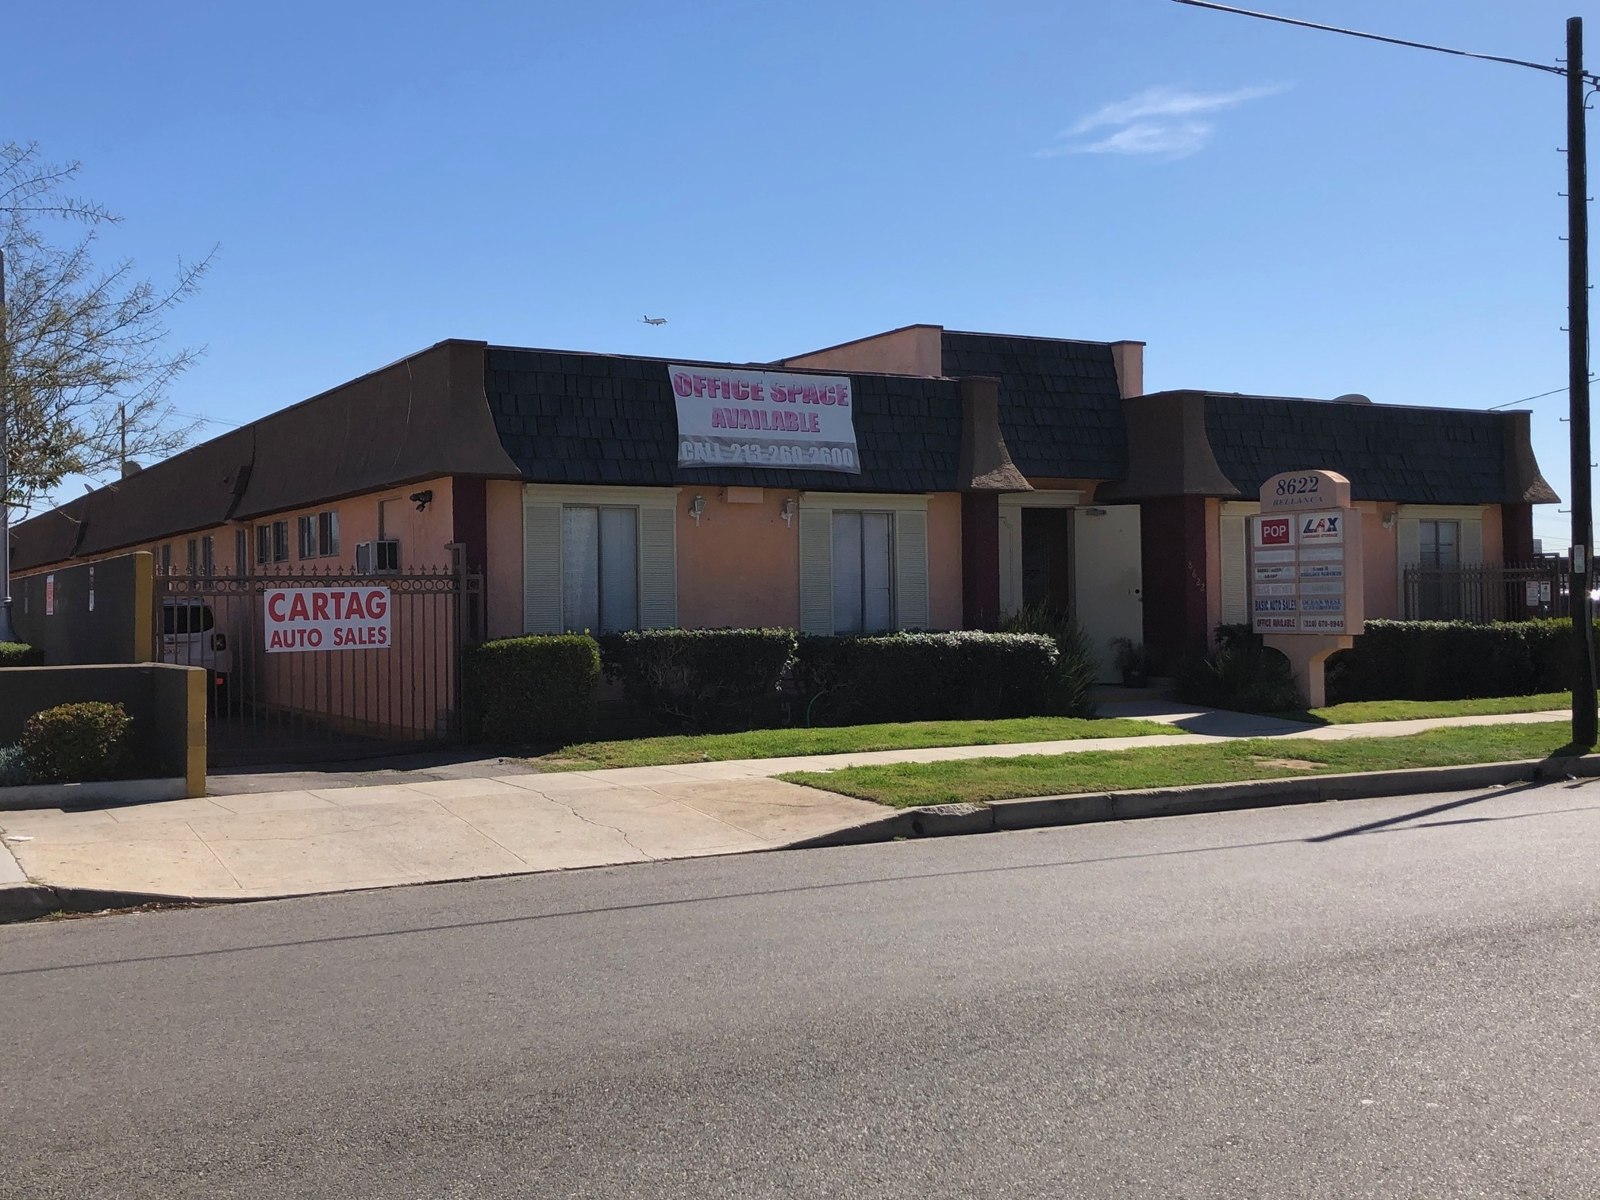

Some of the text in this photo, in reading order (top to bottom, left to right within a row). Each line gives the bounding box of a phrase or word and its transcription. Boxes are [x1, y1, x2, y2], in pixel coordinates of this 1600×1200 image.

[674, 373, 849, 406] OFFICE SPACE
[712, 407, 821, 432] AVAILABLE
[681, 441, 721, 461] CALL
[1276, 476, 1319, 495] 8622
[1272, 496, 1323, 506] BELLANCA
[1263, 525, 1287, 537] POP
[1303, 517, 1339, 533] LAX
[268, 590, 387, 622] CARTAG
[1255, 599, 1269, 611] BASIC
[1270, 599, 1282, 610] AUTO
[1283, 599, 1297, 610] SALES
[1257, 618, 1296, 627] OFFICE AVAILABLE
[270, 626, 387, 648] AUTO SALES
